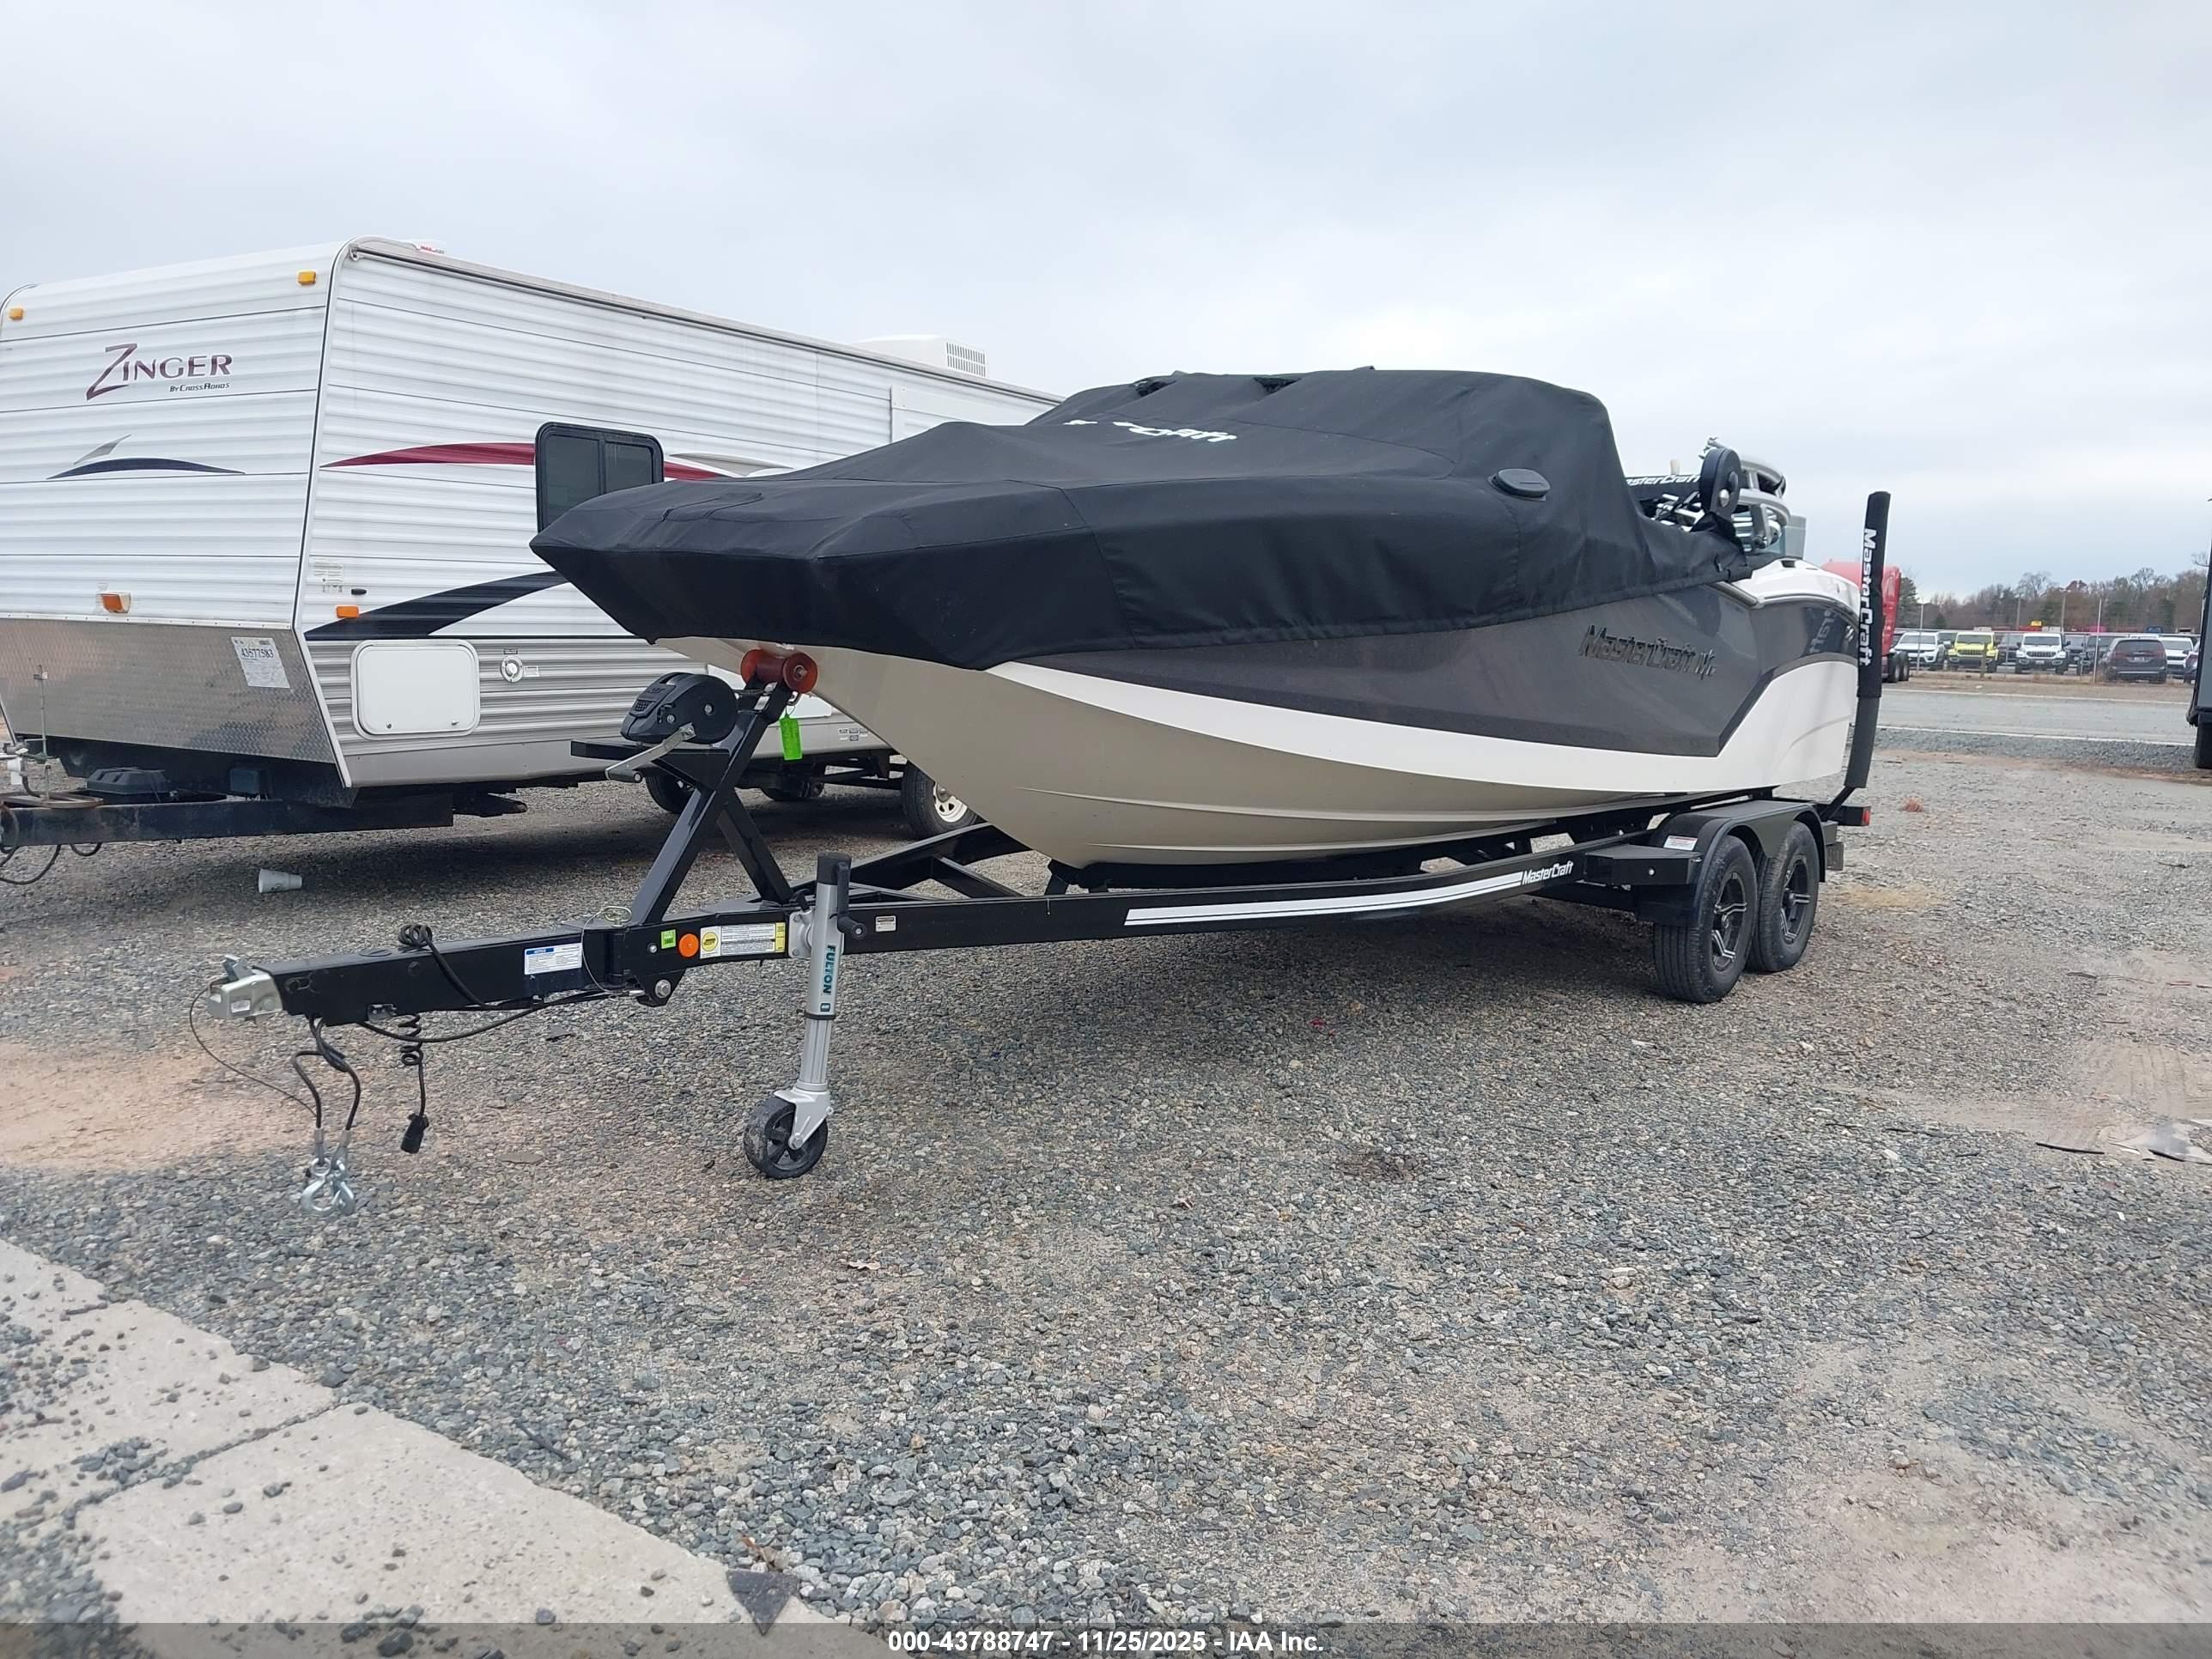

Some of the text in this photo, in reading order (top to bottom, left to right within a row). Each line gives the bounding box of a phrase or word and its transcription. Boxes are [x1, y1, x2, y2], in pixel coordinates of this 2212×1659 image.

[86, 343, 233, 401] ZINGER
[1859, 528, 1877, 666] MasterCraft
[1579, 624, 1697, 673] MasterCraft
[1522, 860, 1574, 885] MasterCraft
[823, 945, 836, 994] FULTON
